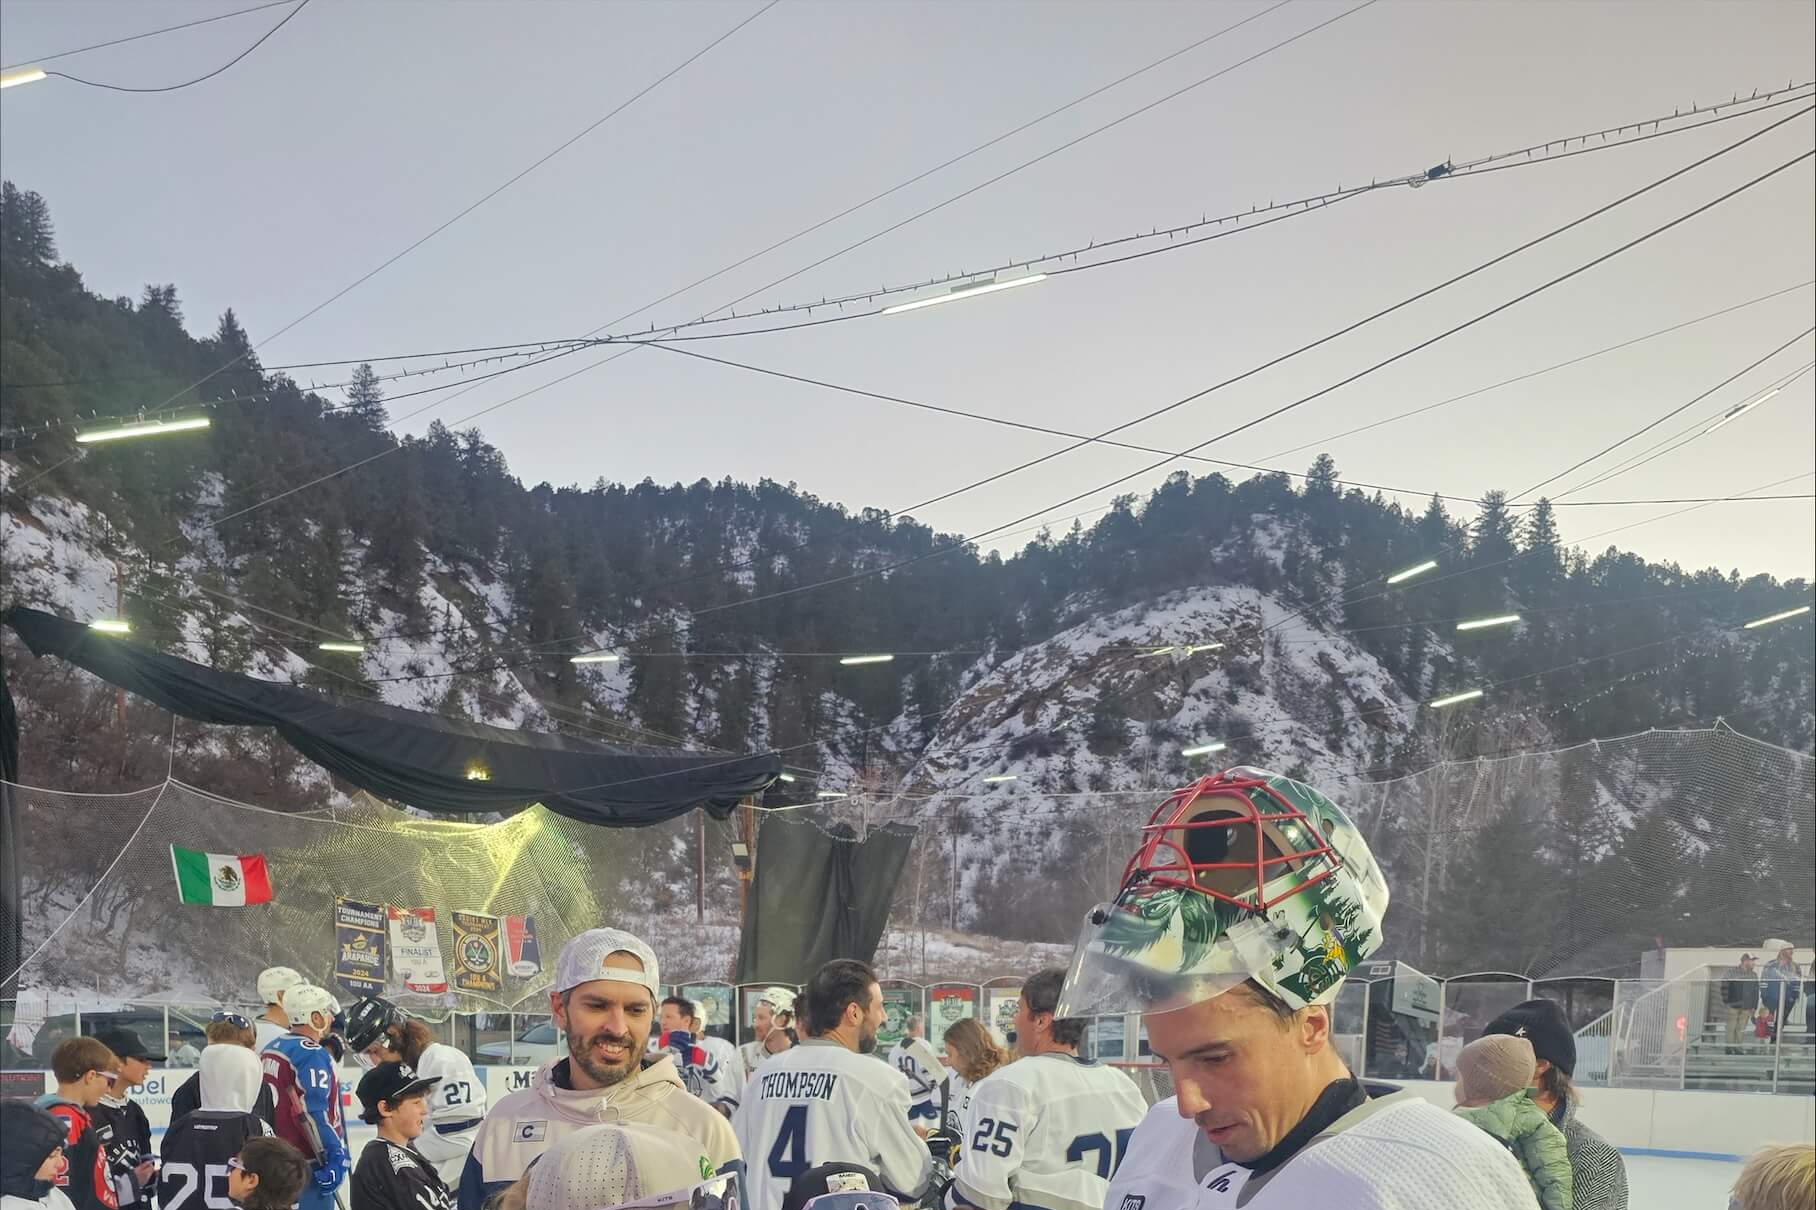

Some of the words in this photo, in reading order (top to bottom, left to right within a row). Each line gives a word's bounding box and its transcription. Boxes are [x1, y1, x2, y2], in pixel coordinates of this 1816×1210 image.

[337, 906, 383, 921] TOURNAMENT
[340, 914, 380, 928] CHAMPIONS
[401, 948, 433, 956] FINALIST
[352, 968, 369, 977] 2024
[414, 984, 431, 993] 2024
[309, 1068, 329, 1089] 12
[760, 1071, 838, 1101] THOMPSON
[443, 1081, 472, 1105] 27
[522, 1125, 534, 1139] C
[971, 1117, 1018, 1158] 25
[768, 1105, 812, 1192] 4
